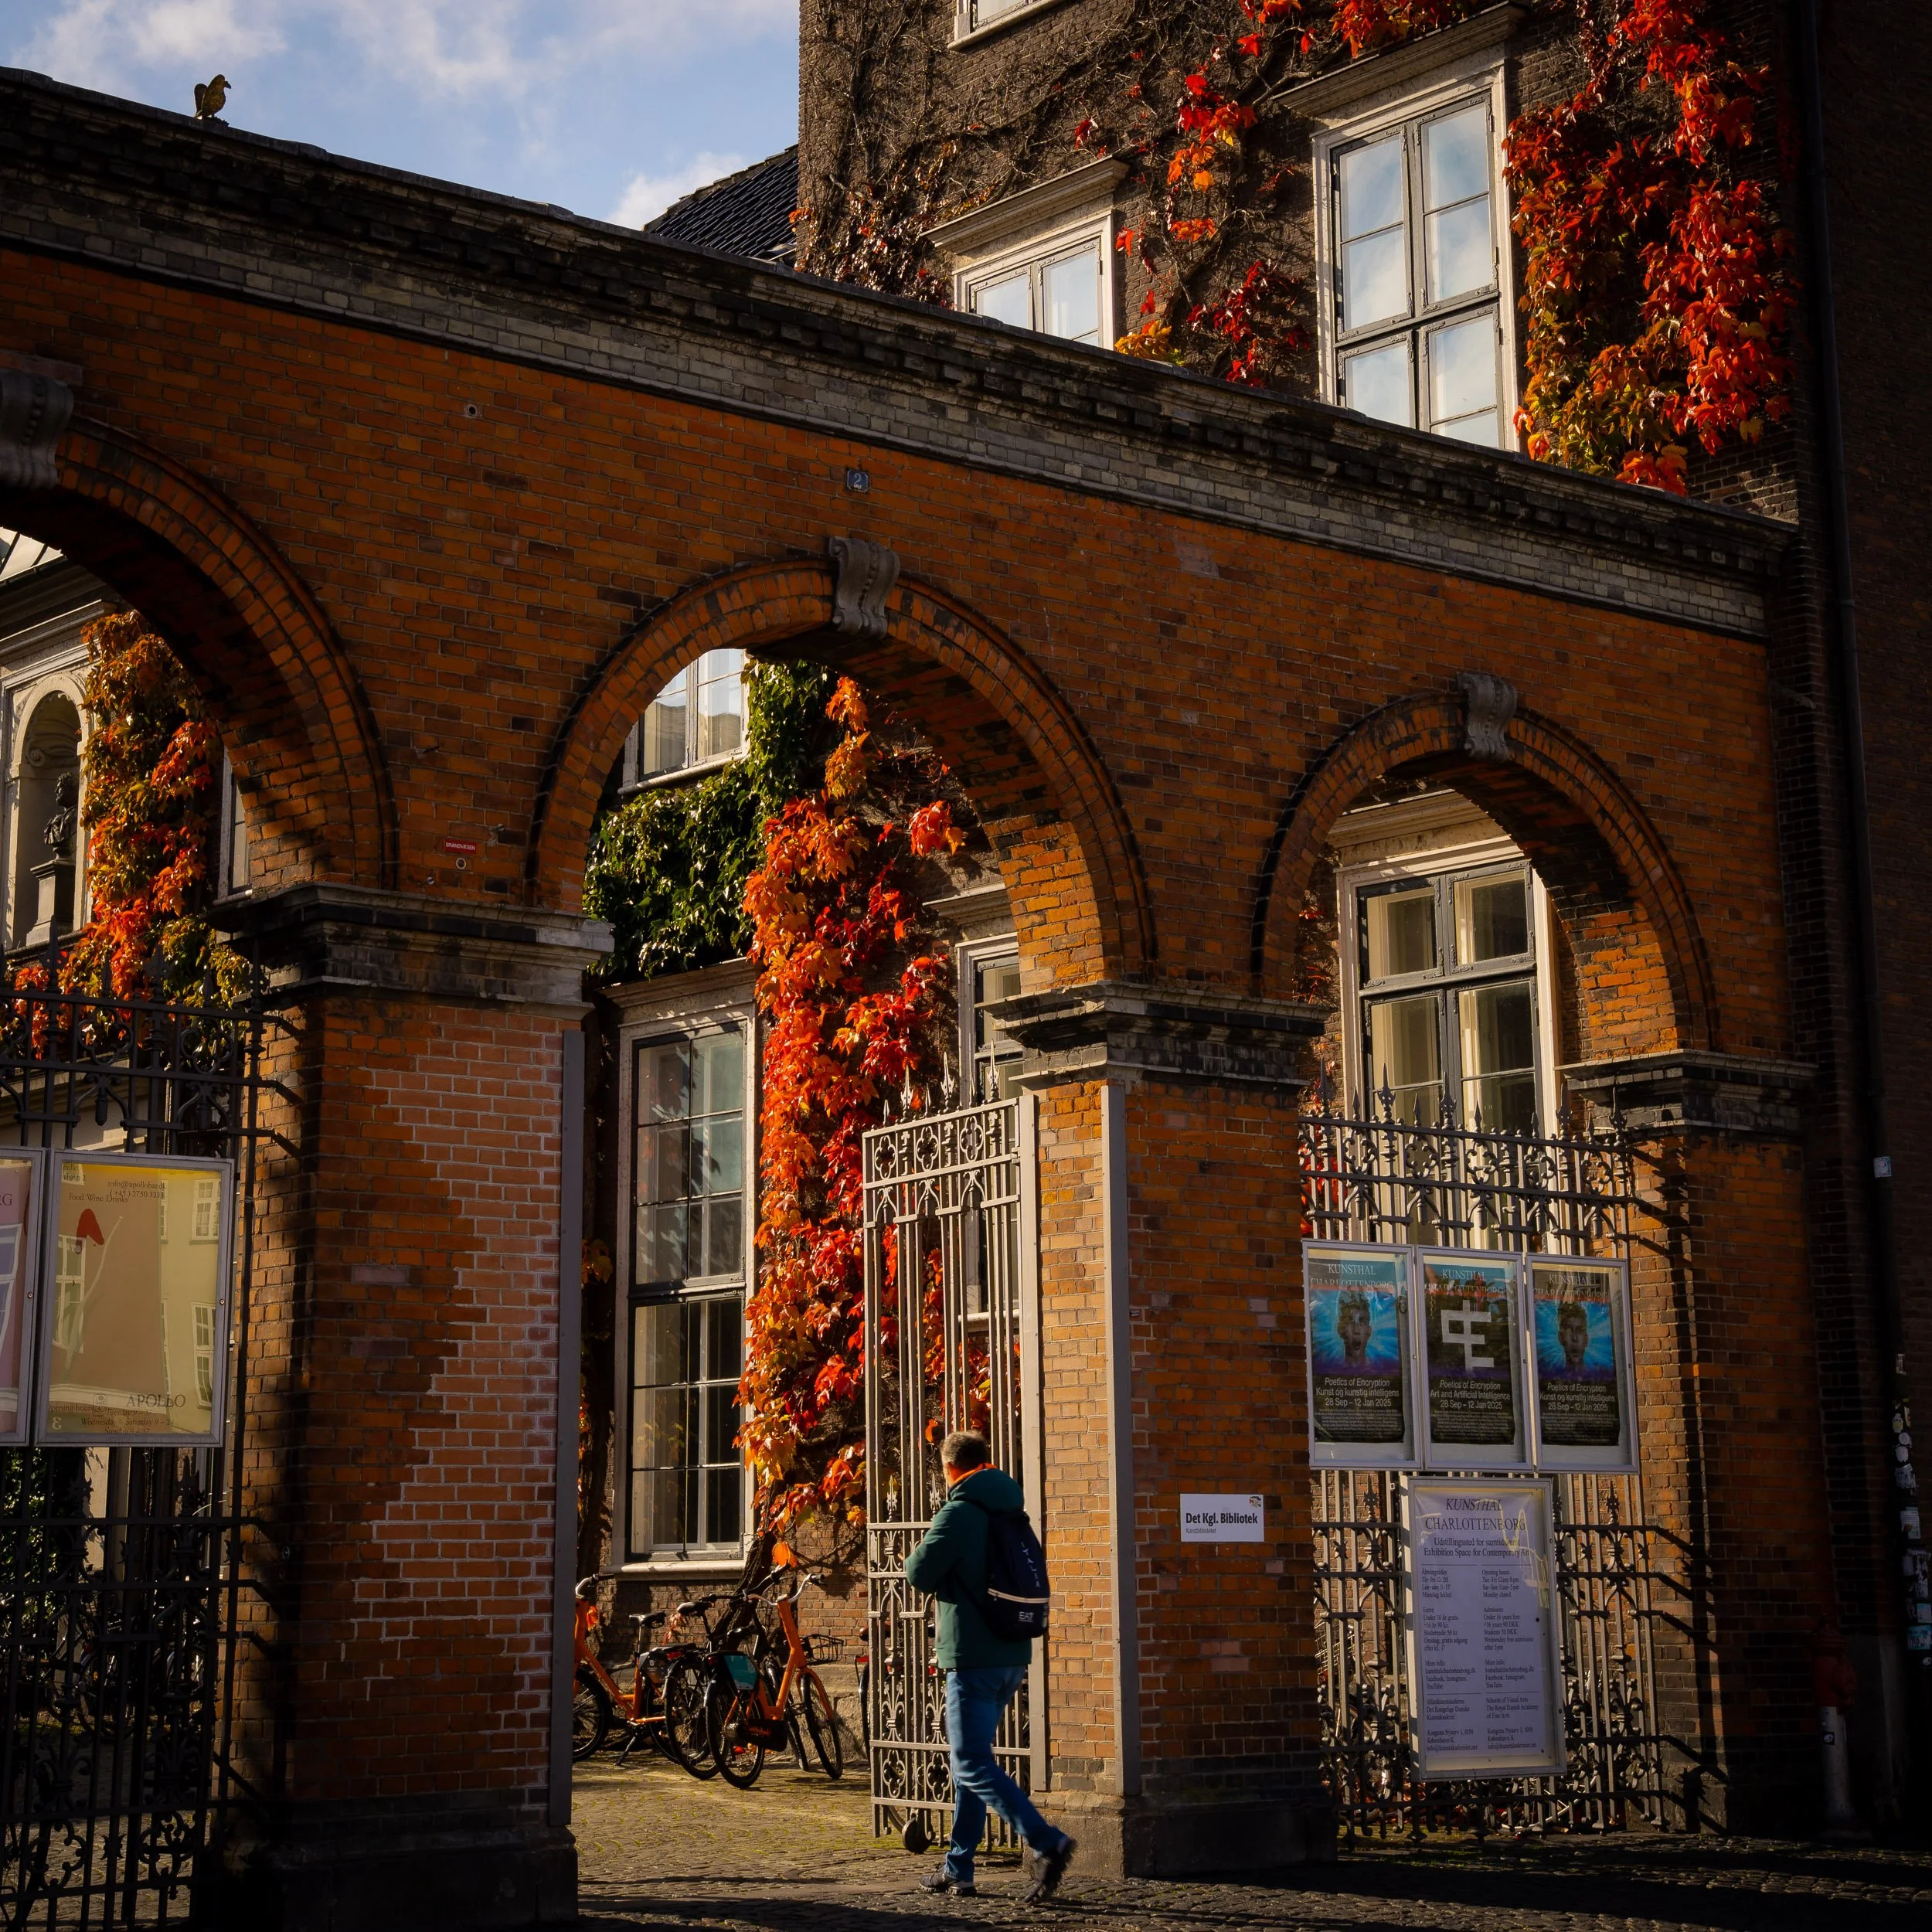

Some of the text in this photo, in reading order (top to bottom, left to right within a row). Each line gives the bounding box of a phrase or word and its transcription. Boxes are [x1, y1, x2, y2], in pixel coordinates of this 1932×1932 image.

[854, 472, 862, 489] 2
[69, 1192, 128, 1203] Food Wine Drinks
[1328, 1264, 1376, 1275] KUNSTHAL
[1442, 1269, 1487, 1281] KUNSTHAL
[1325, 1377, 1347, 1386] Poetics
[1356, 1378, 1390, 1388] Encryption
[1440, 1379, 1461, 1388] Poetics
[1470, 1380, 1501, 1391] Encryption
[1547, 1383, 1607, 1393] Poetics of Encryption
[1316, 1387, 1335, 1396] Kunst
[1345, 1388, 1367, 1398] kunstig
[1369, 1388, 1400, 1398] intelligens
[1478, 1392, 1511, 1401] Intelligence
[1556, 1394, 1565, 1403] og
[1566, 1393, 1587, 1403] kunstig
[1587, 1393, 1615, 1403] intelligens
[127, 1393, 186, 1407] APOLLO
[1325, 1397, 1392, 1407] 28 Sep 12 Jan 2025
[1440, 1400, 1449, 1408] 28
[1450, 1400, 1461, 1410] Sep
[1487, 1401, 1503, 1410] 2025
[1556, 1403, 1570, 1412] Sep
[1446, 1498, 1503, 1511] KUNSTHAL
[1185, 1512, 1258, 1526] Det Kgl. Bibliotek
[1425, 1518, 1526, 1531] CHARLOTTENBORG
[1434, 1538, 1474, 1547] Udstillingssted
[1423, 1547, 1454, 1556] Exhibition
[1454, 1548, 1471, 1559] Space
[1482, 1548, 1519, 1559] Contemporary
[1020, 1541, 1041, 1588] ITALIA
